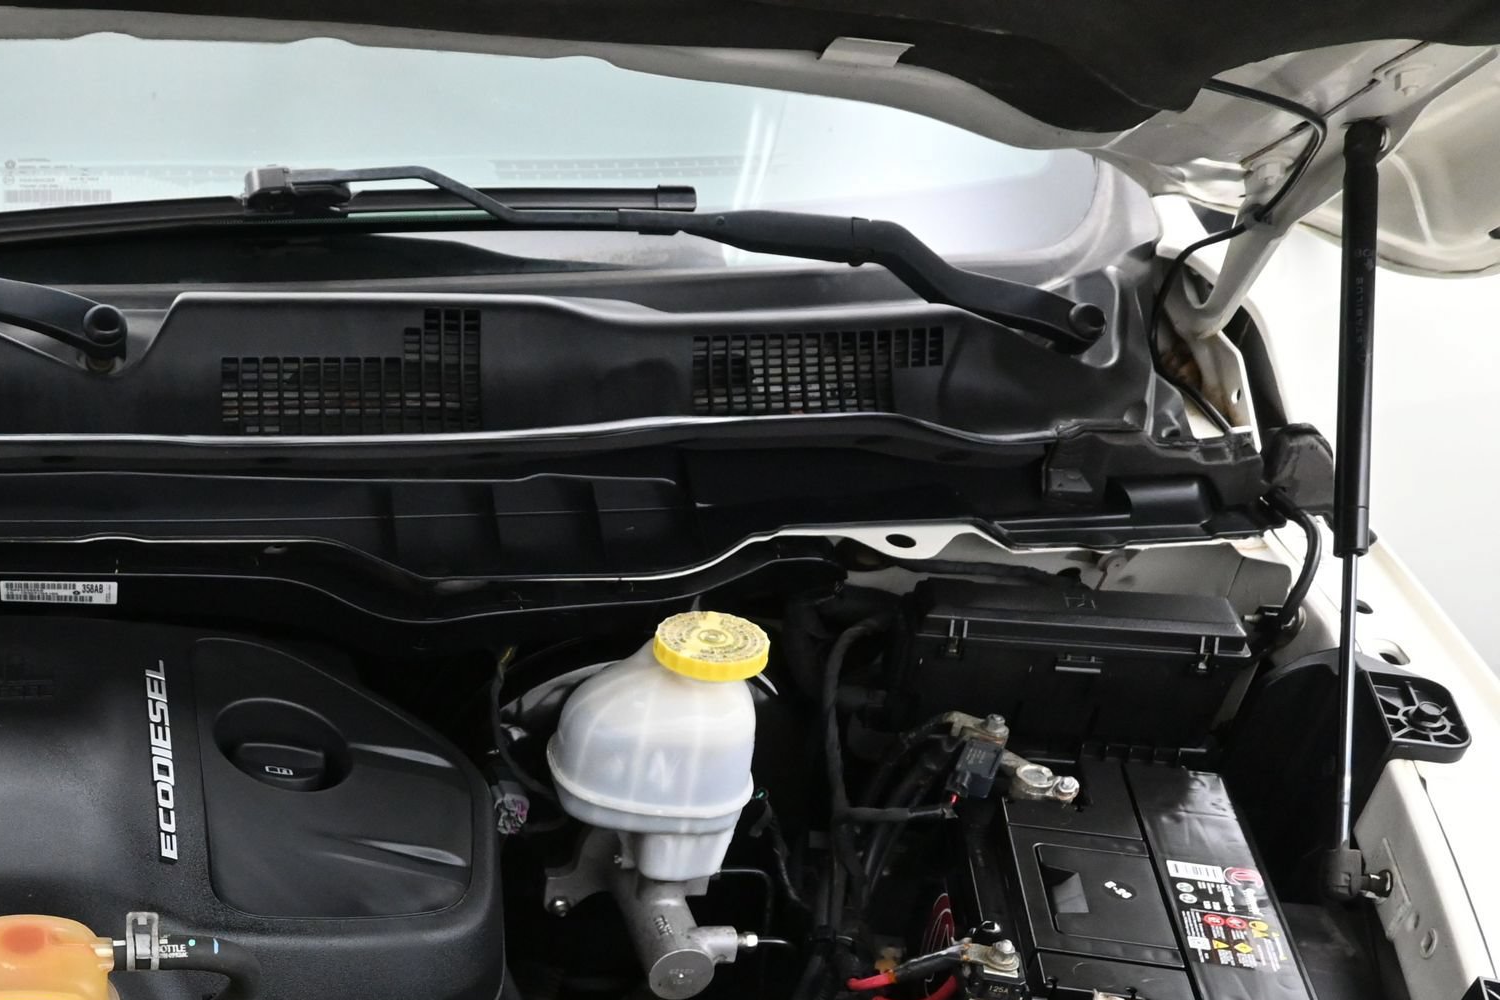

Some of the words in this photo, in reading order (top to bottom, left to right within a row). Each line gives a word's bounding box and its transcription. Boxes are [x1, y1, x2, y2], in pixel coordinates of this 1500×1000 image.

[81, 584, 104, 594] 358AB
[145, 659, 178, 860] ECODIESEL
[159, 943, 187, 953] OTTLE
[989, 985, 1009, 994] 125A
